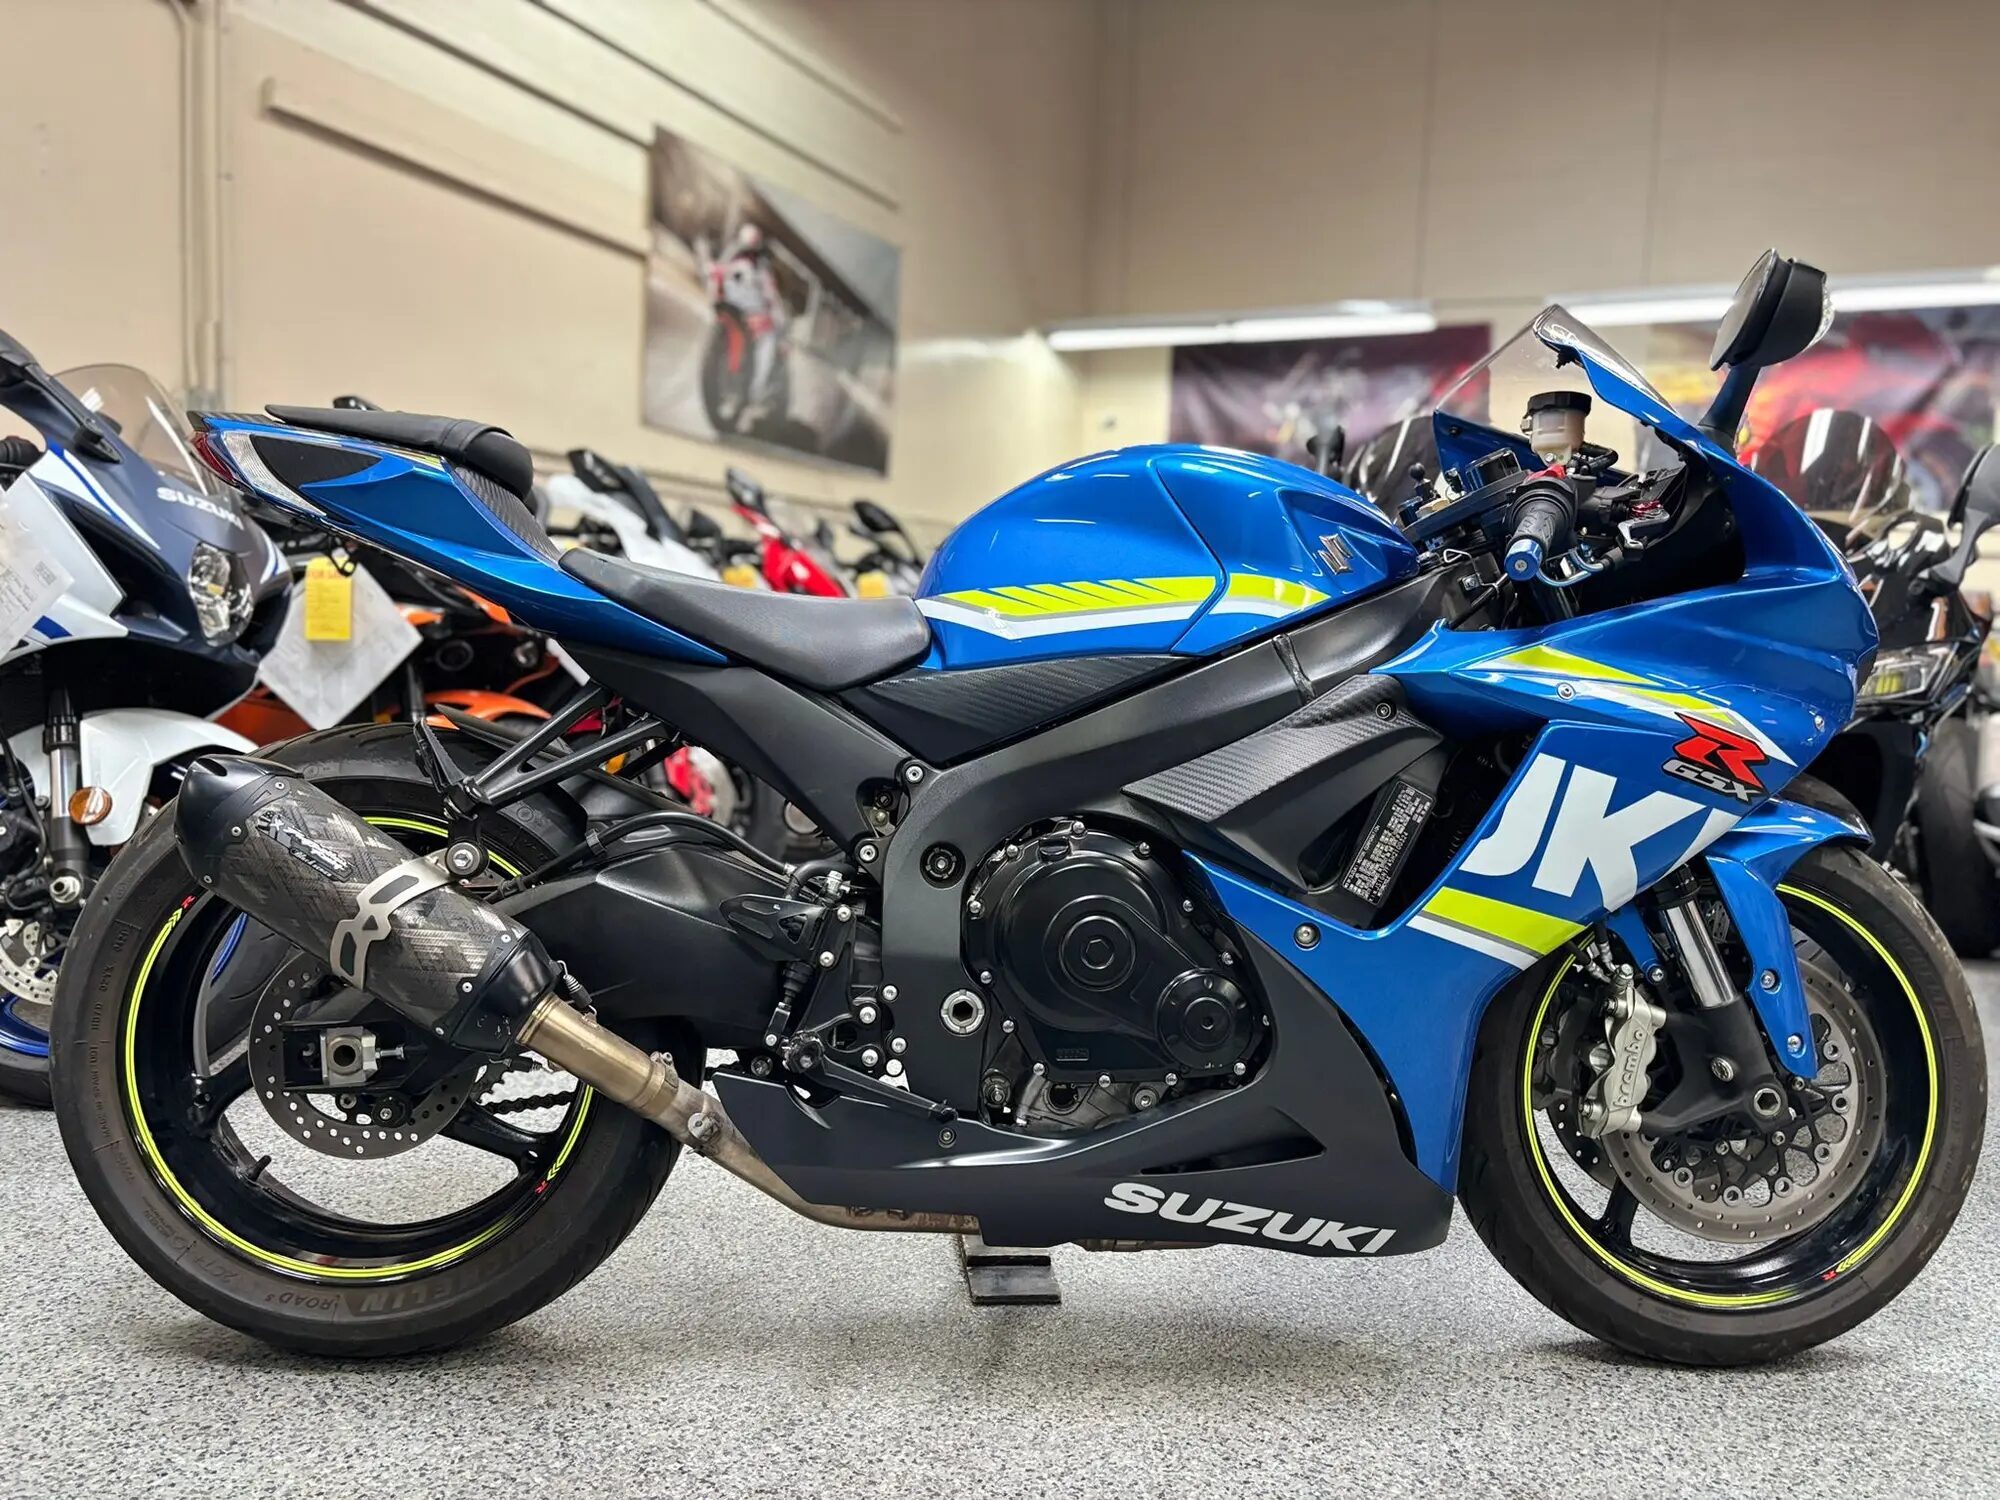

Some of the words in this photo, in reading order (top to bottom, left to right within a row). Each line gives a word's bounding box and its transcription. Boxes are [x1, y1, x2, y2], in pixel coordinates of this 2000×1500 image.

[156, 487, 244, 530] SUZUKI
[1674, 711, 1765, 789] R
[1662, 759, 1761, 801] GSX
[1612, 1029, 1645, 1108] brembo
[1103, 1182, 1397, 1253] SUZUKI
[278, 1291, 333, 1311] ROAD
